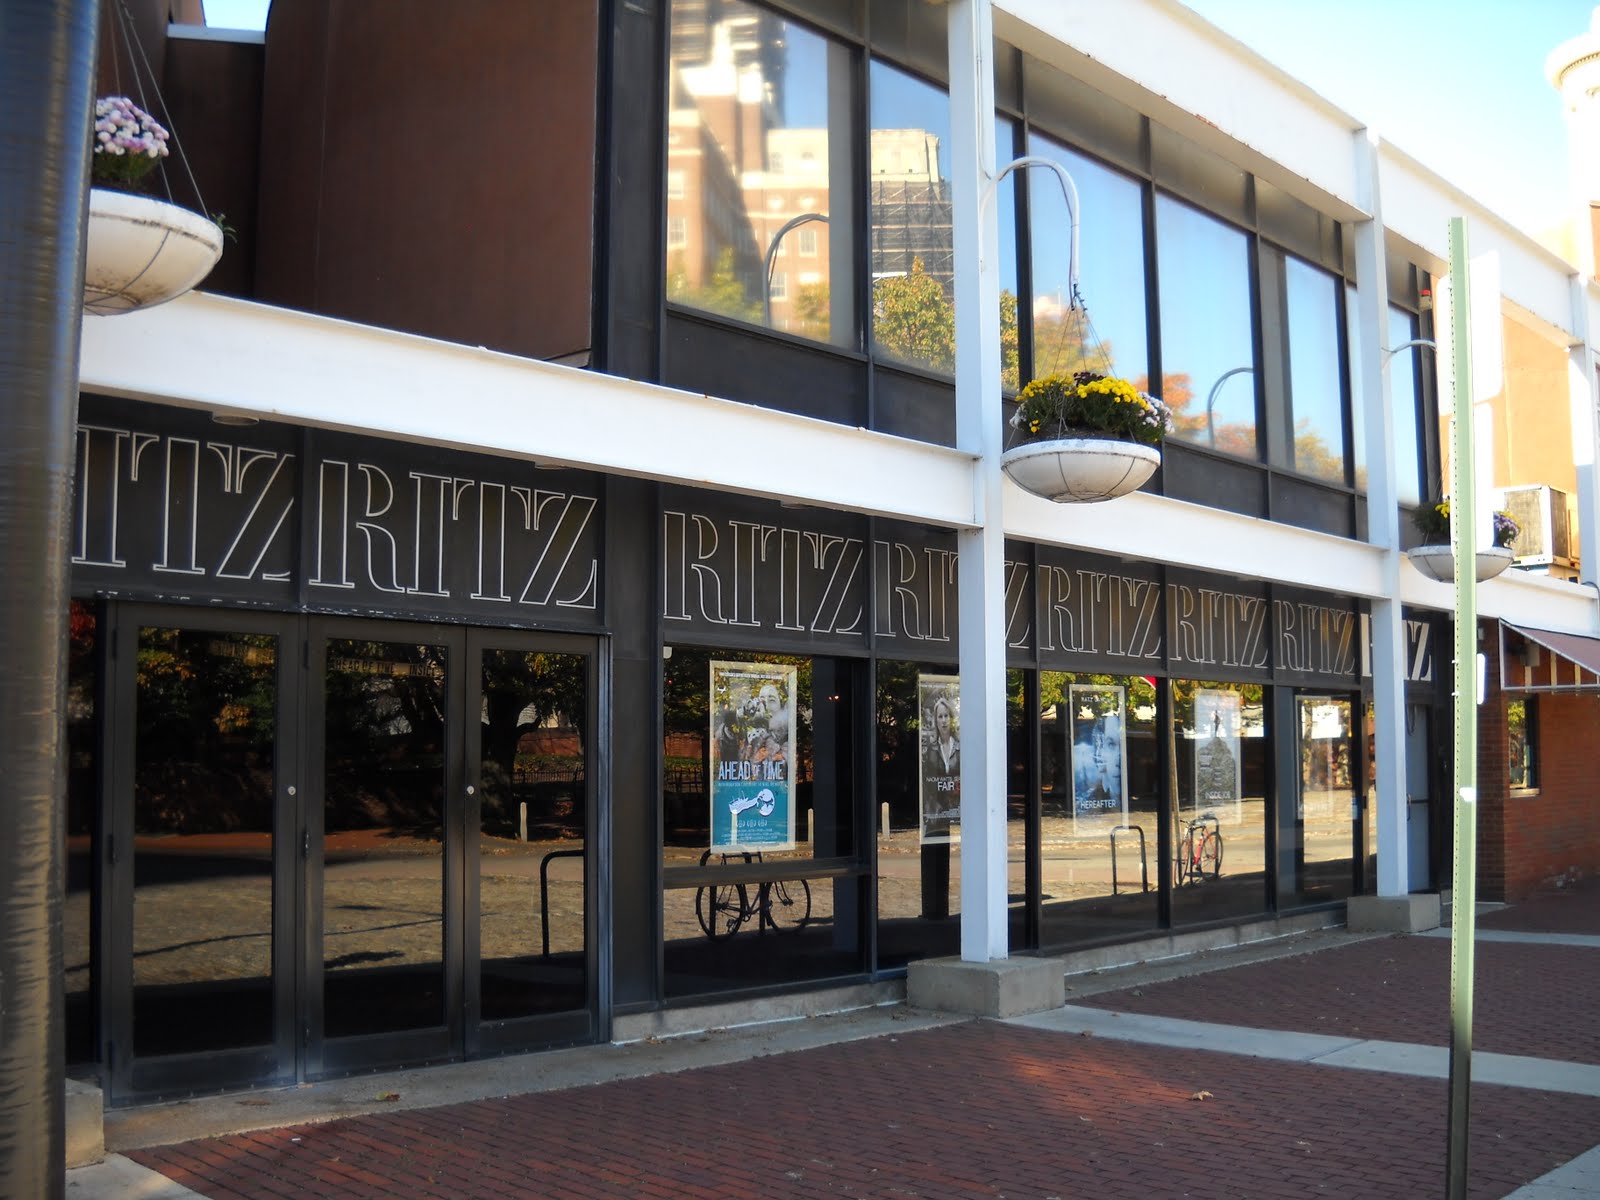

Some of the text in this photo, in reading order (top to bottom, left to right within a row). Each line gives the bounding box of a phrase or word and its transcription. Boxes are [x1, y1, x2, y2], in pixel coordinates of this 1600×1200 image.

[72, 425, 295, 582] ITZ
[309, 459, 598, 610] RITZ
[664, 511, 863, 636] RITZ
[1038, 564, 1161, 659] RITZ
[1169, 584, 1268, 669] RITZ
[1275, 600, 1355, 675] RITZ
[718, 760, 784, 780] AHEAD OF TIME
[938, 781, 955, 791] FAIR
[1080, 799, 1116, 809] HEREAFTER
